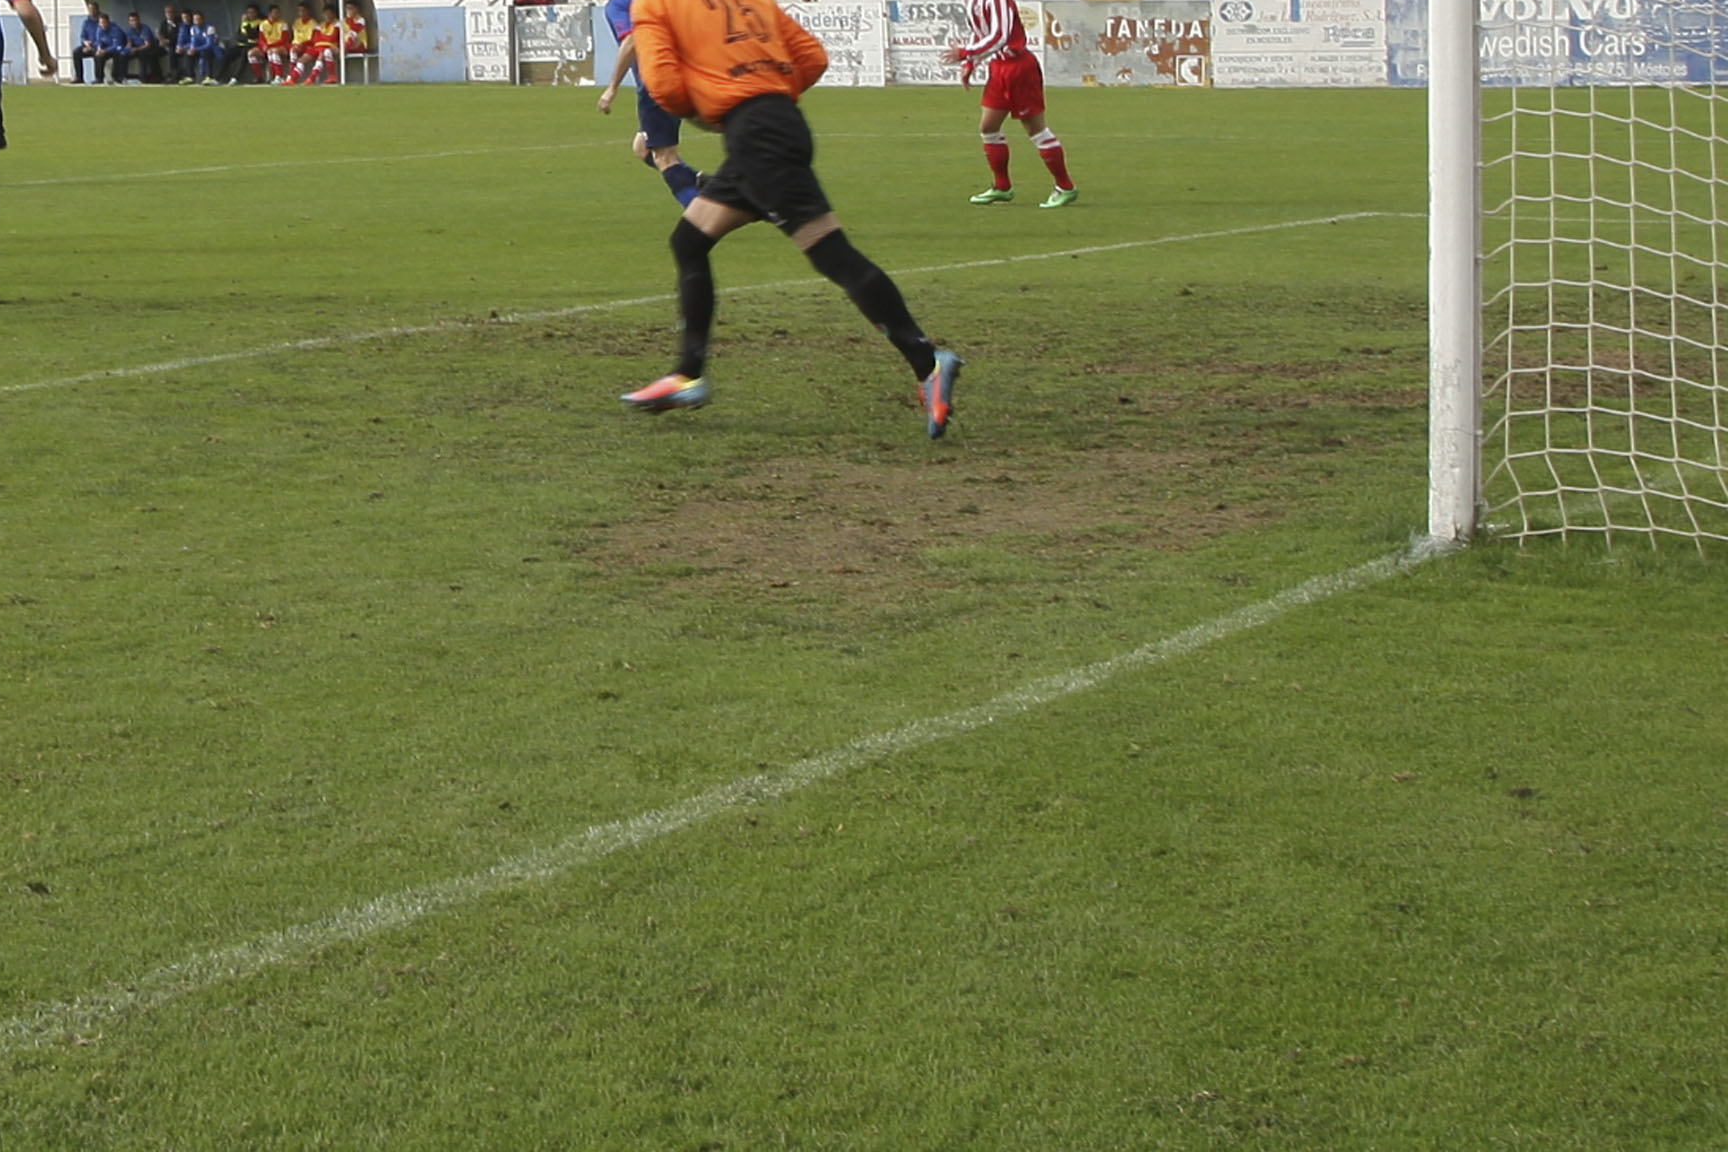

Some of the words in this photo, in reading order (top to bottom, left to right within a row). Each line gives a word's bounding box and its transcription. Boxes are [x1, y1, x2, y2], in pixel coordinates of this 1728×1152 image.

[1051, 19, 1204, 38] CTANEDA
[1479, 25, 1570, 57] wedish
[1579, 25, 1646, 57] Cars
[1633, 62, 1688, 77] Móstoes
